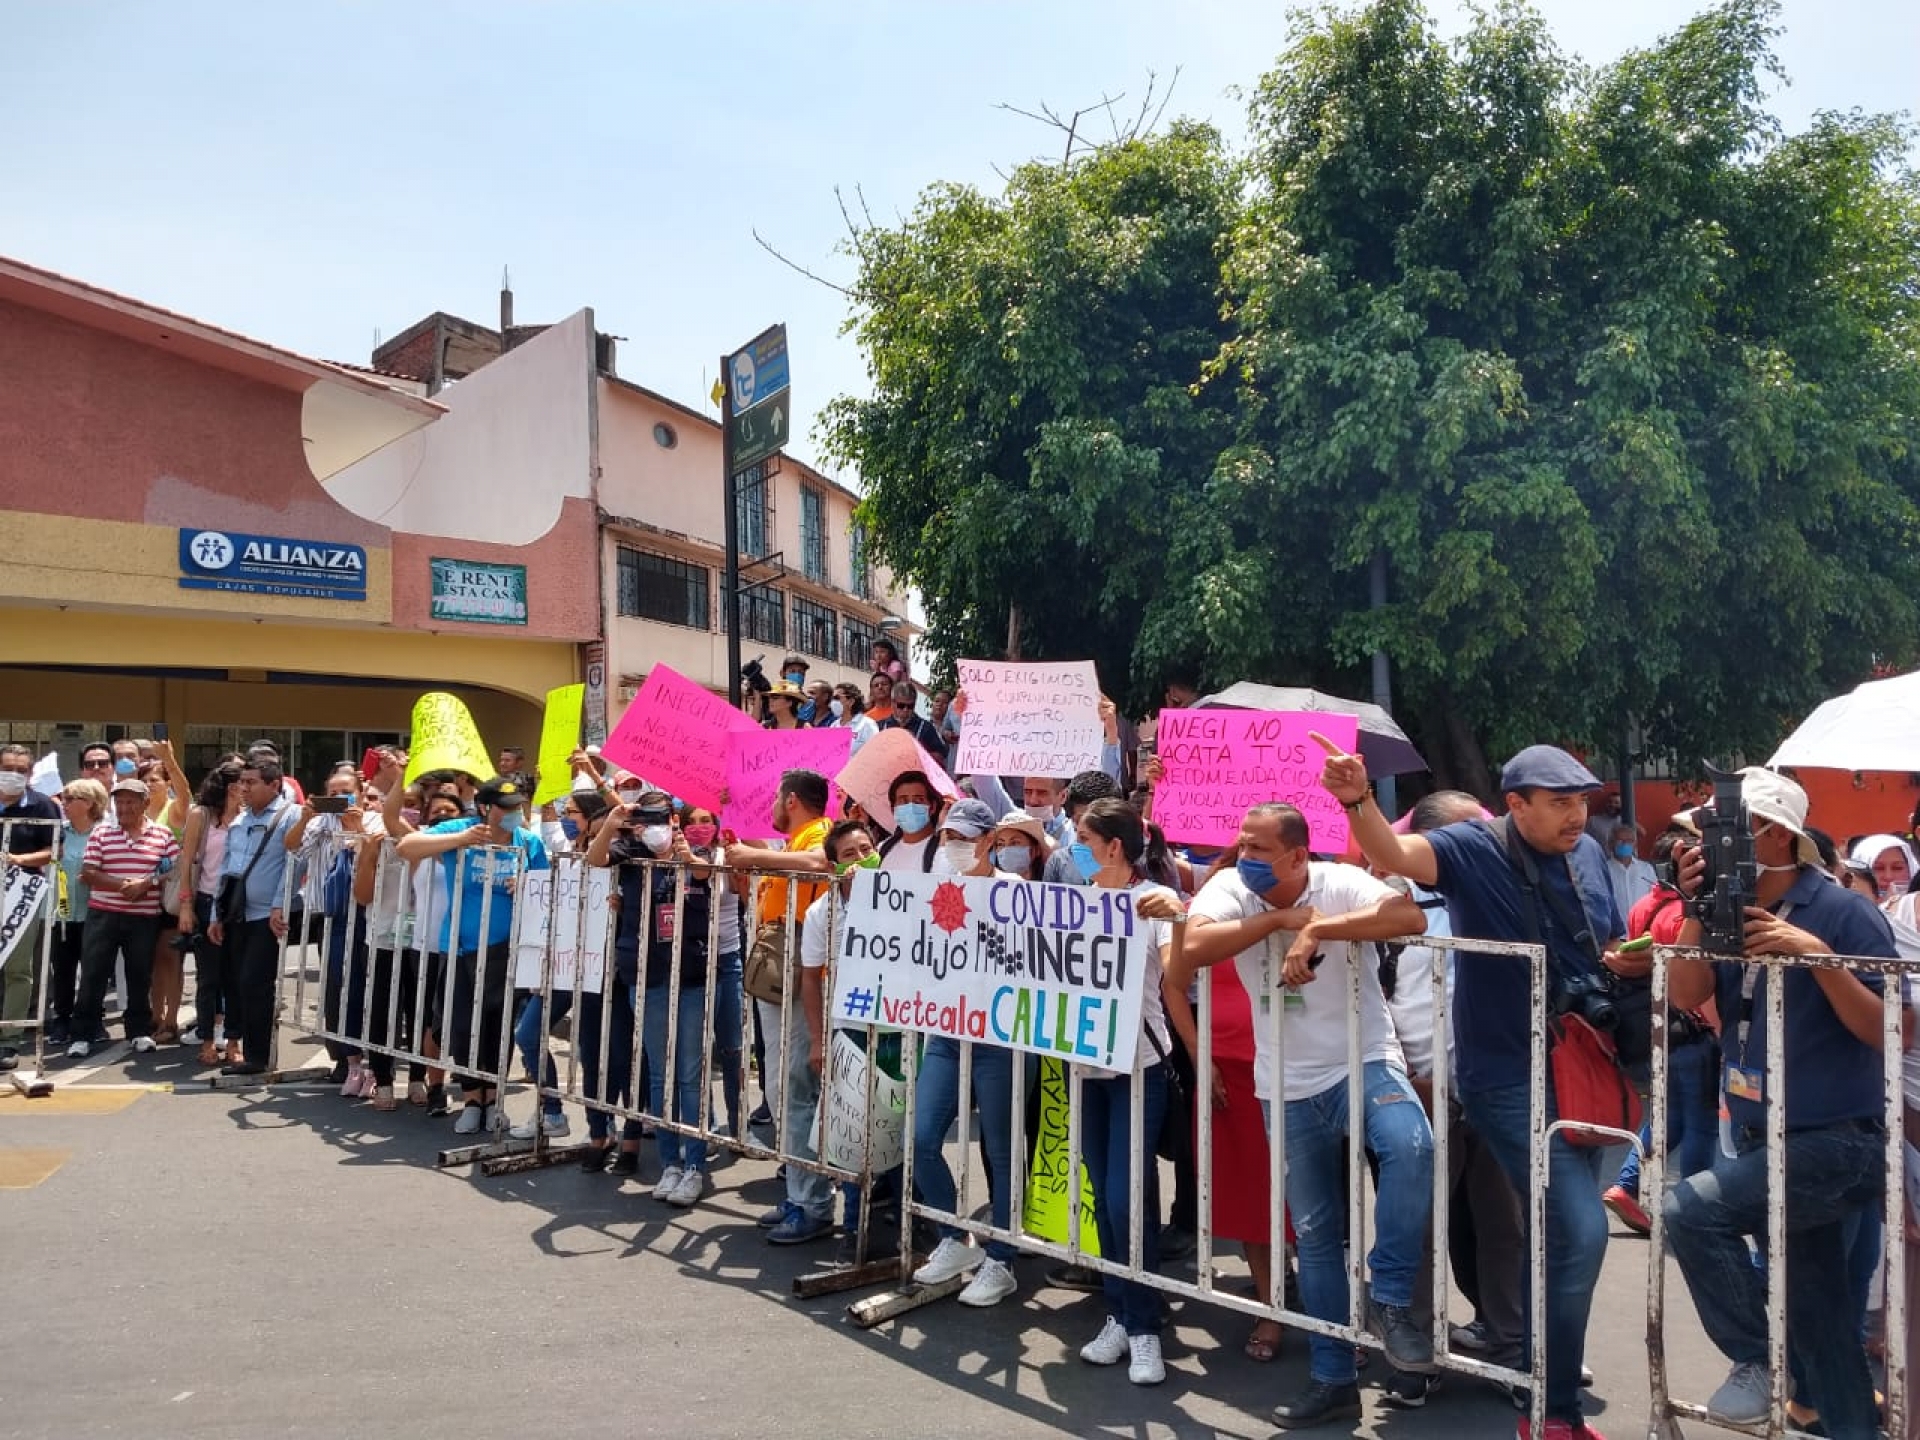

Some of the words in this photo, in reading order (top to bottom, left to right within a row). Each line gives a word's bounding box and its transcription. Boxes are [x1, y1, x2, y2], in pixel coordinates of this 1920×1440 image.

[242, 541, 363, 570] ALIANZA
[461, 571, 523, 589] RENTA
[443, 585, 478, 598] ESTA
[480, 587, 518, 601] CASA
[959, 665, 996, 684] SOLO
[1004, 670, 1084, 688] EXIGIMOS
[964, 711, 984, 727] DE
[994, 708, 1065, 727] NUESTRO
[1160, 715, 1227, 740] INEGI
[1244, 718, 1282, 741] NO
[961, 750, 1000, 772] INEGI
[1161, 743, 1233, 765] ACATA
[1251, 744, 1307, 764] TUS
[1162, 765, 1323, 788] RECOMENDACION
[1158, 791, 1169, 807] Y
[1178, 791, 1225, 808] VIOLA
[1231, 792, 1261, 808] LOS
[1153, 814, 1169, 829] DE
[1178, 814, 1203, 830] SUS
[872, 869, 915, 913] Por
[989, 880, 1134, 937] COVID-19
[1027, 926, 1128, 991] INEGI
